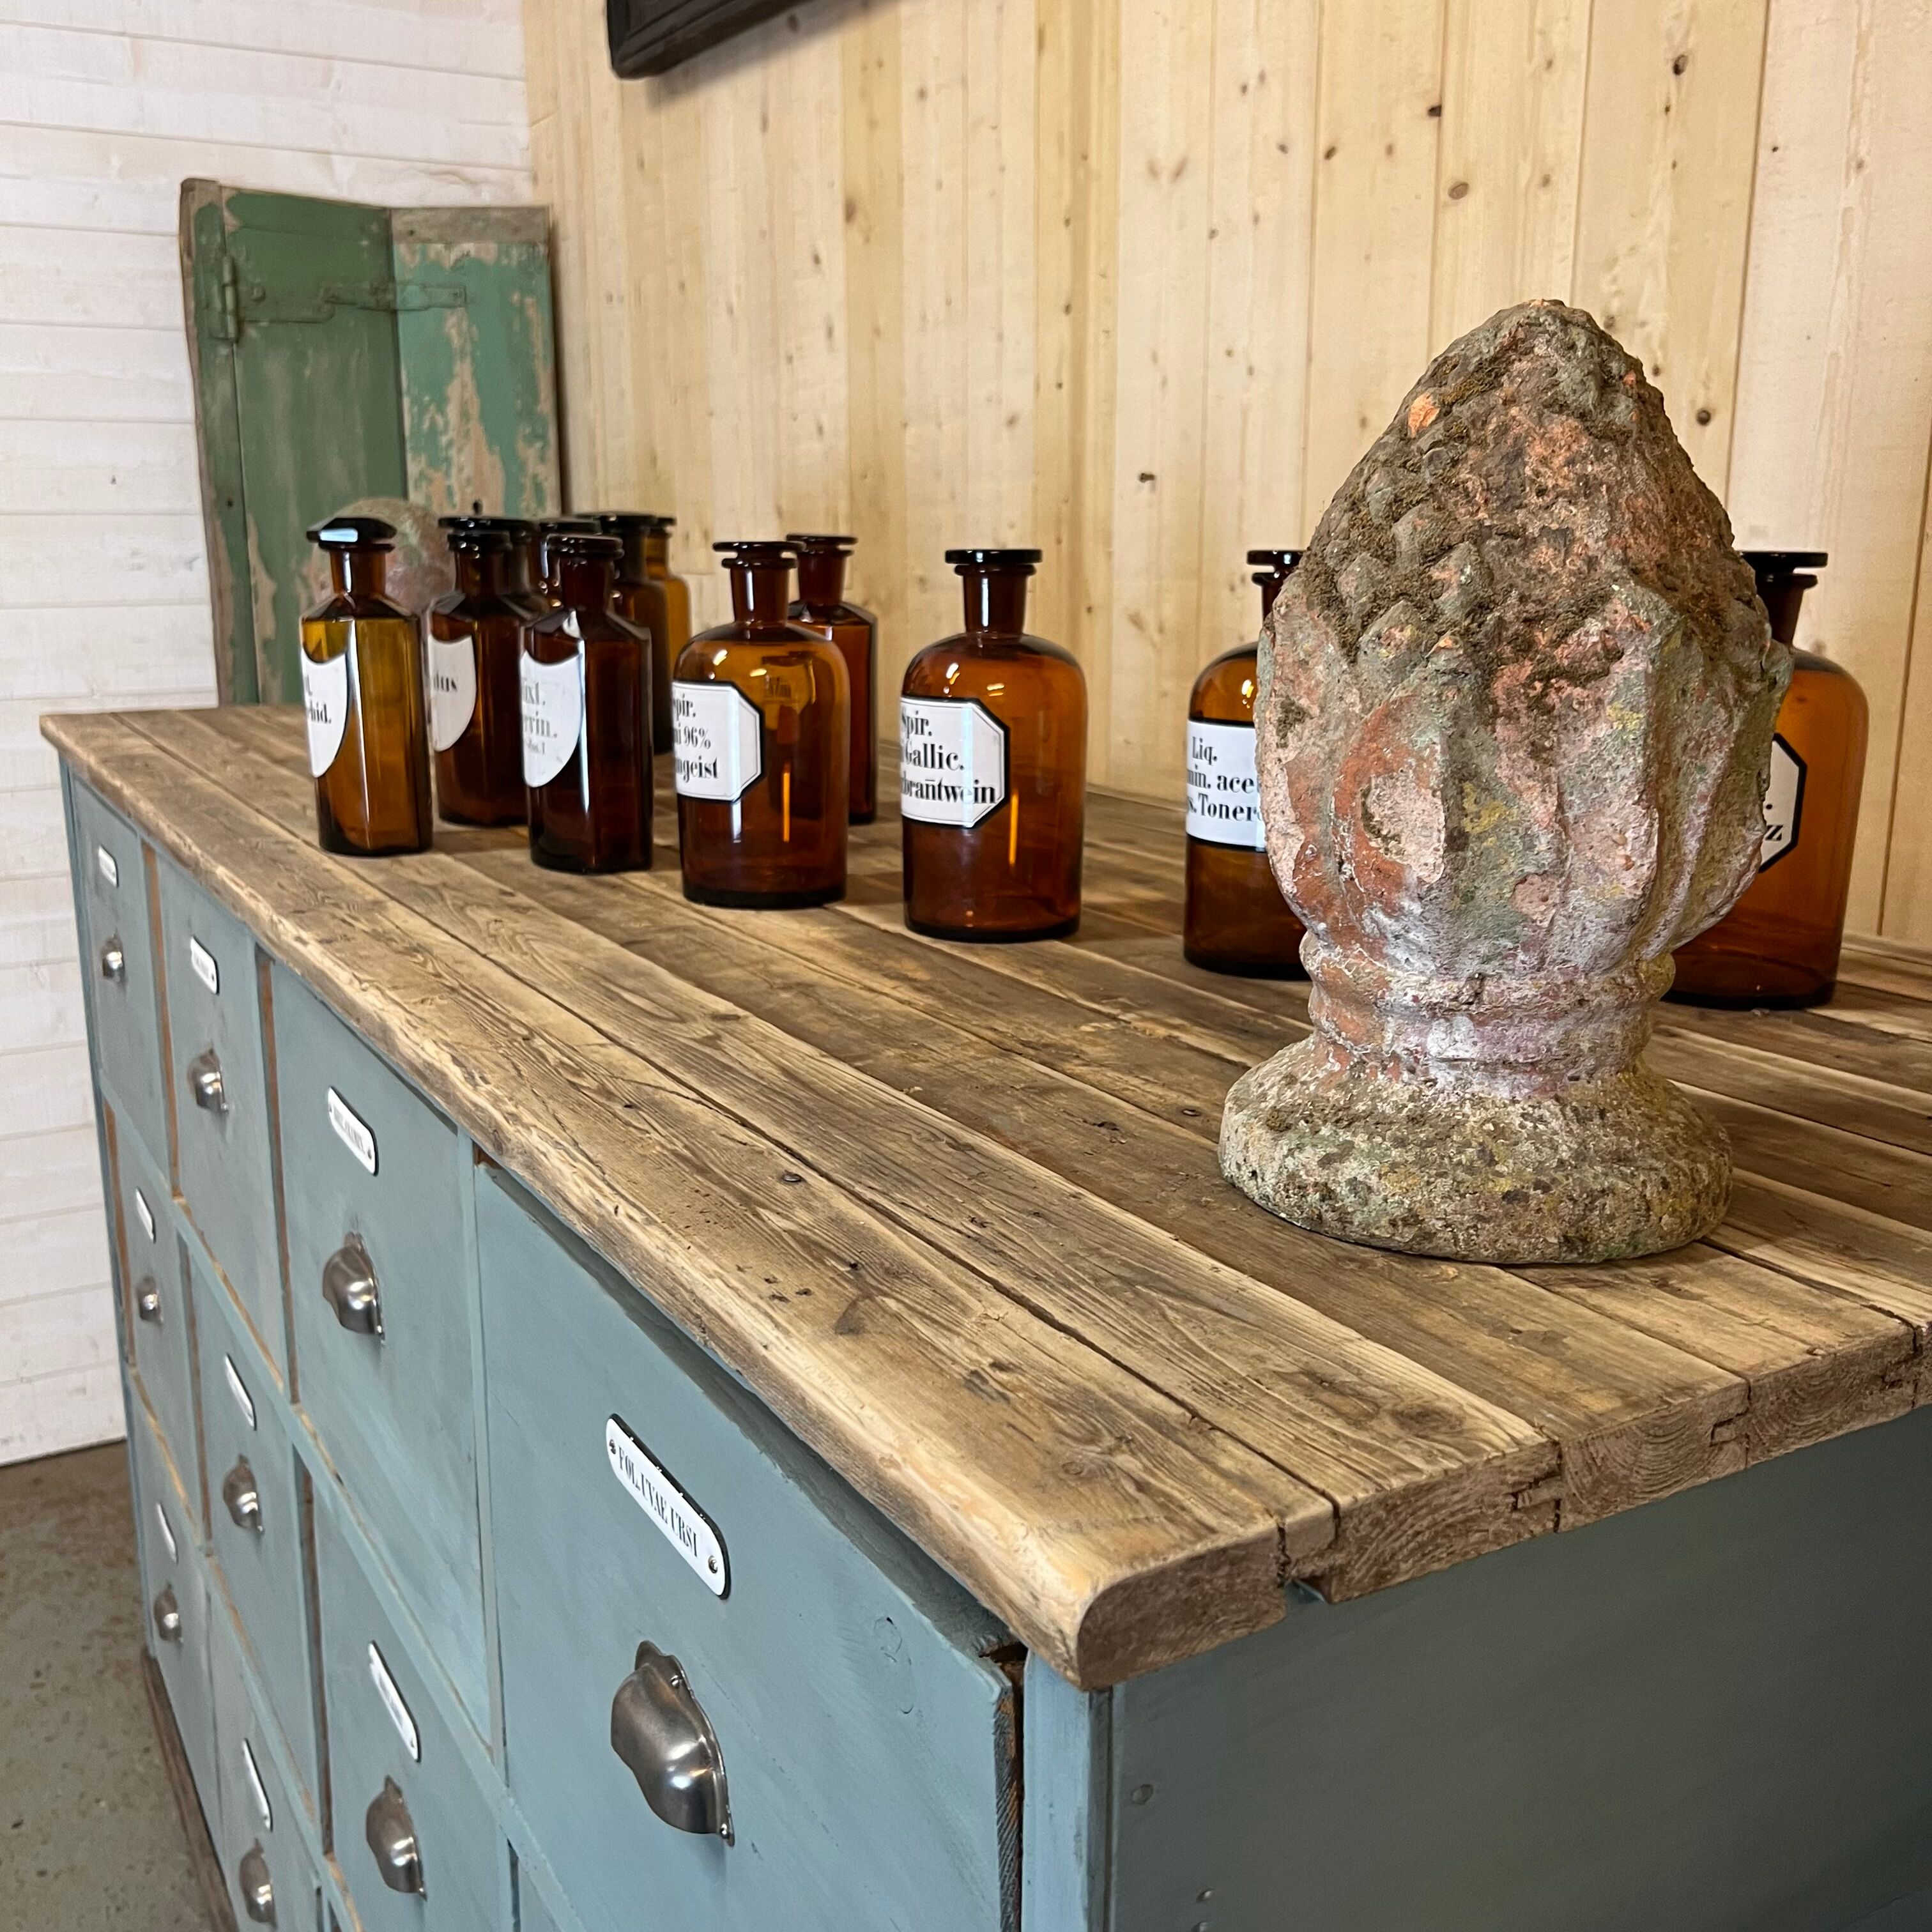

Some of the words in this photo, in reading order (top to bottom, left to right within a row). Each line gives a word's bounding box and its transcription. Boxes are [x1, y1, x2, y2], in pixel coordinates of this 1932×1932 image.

[905, 740, 965, 771] Gallic.
[1192, 736, 1217, 766] Liq.
[1217, 774, 1261, 793] ace
